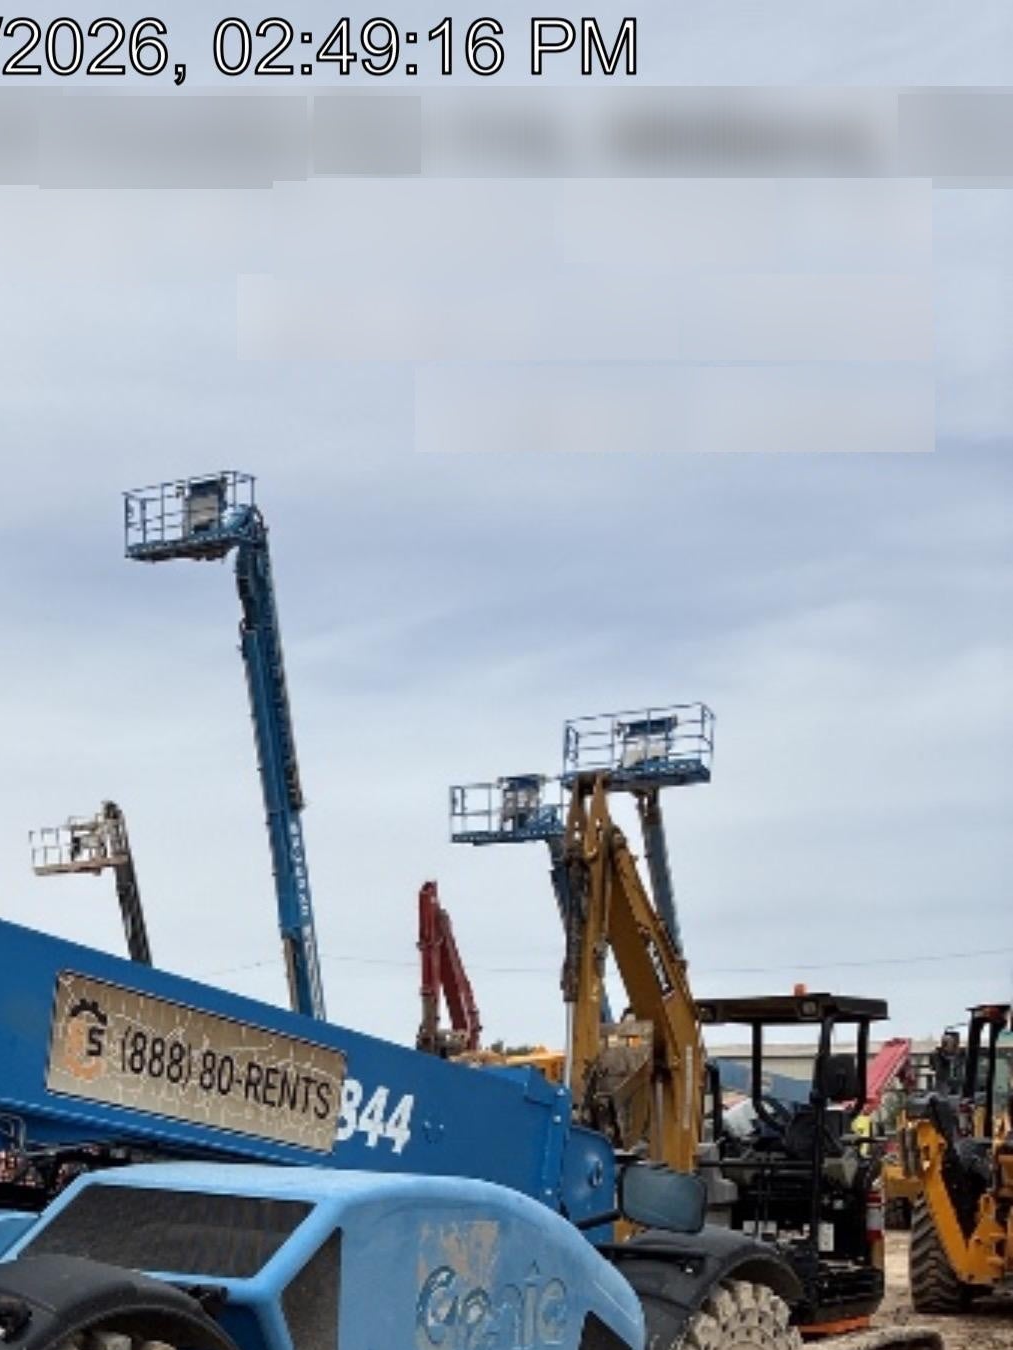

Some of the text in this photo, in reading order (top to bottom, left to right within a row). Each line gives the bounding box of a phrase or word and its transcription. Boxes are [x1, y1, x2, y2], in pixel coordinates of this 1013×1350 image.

[121, 1025, 333, 1120] (888) 80-RENTS
[334, 1078, 415, 1155] 844
